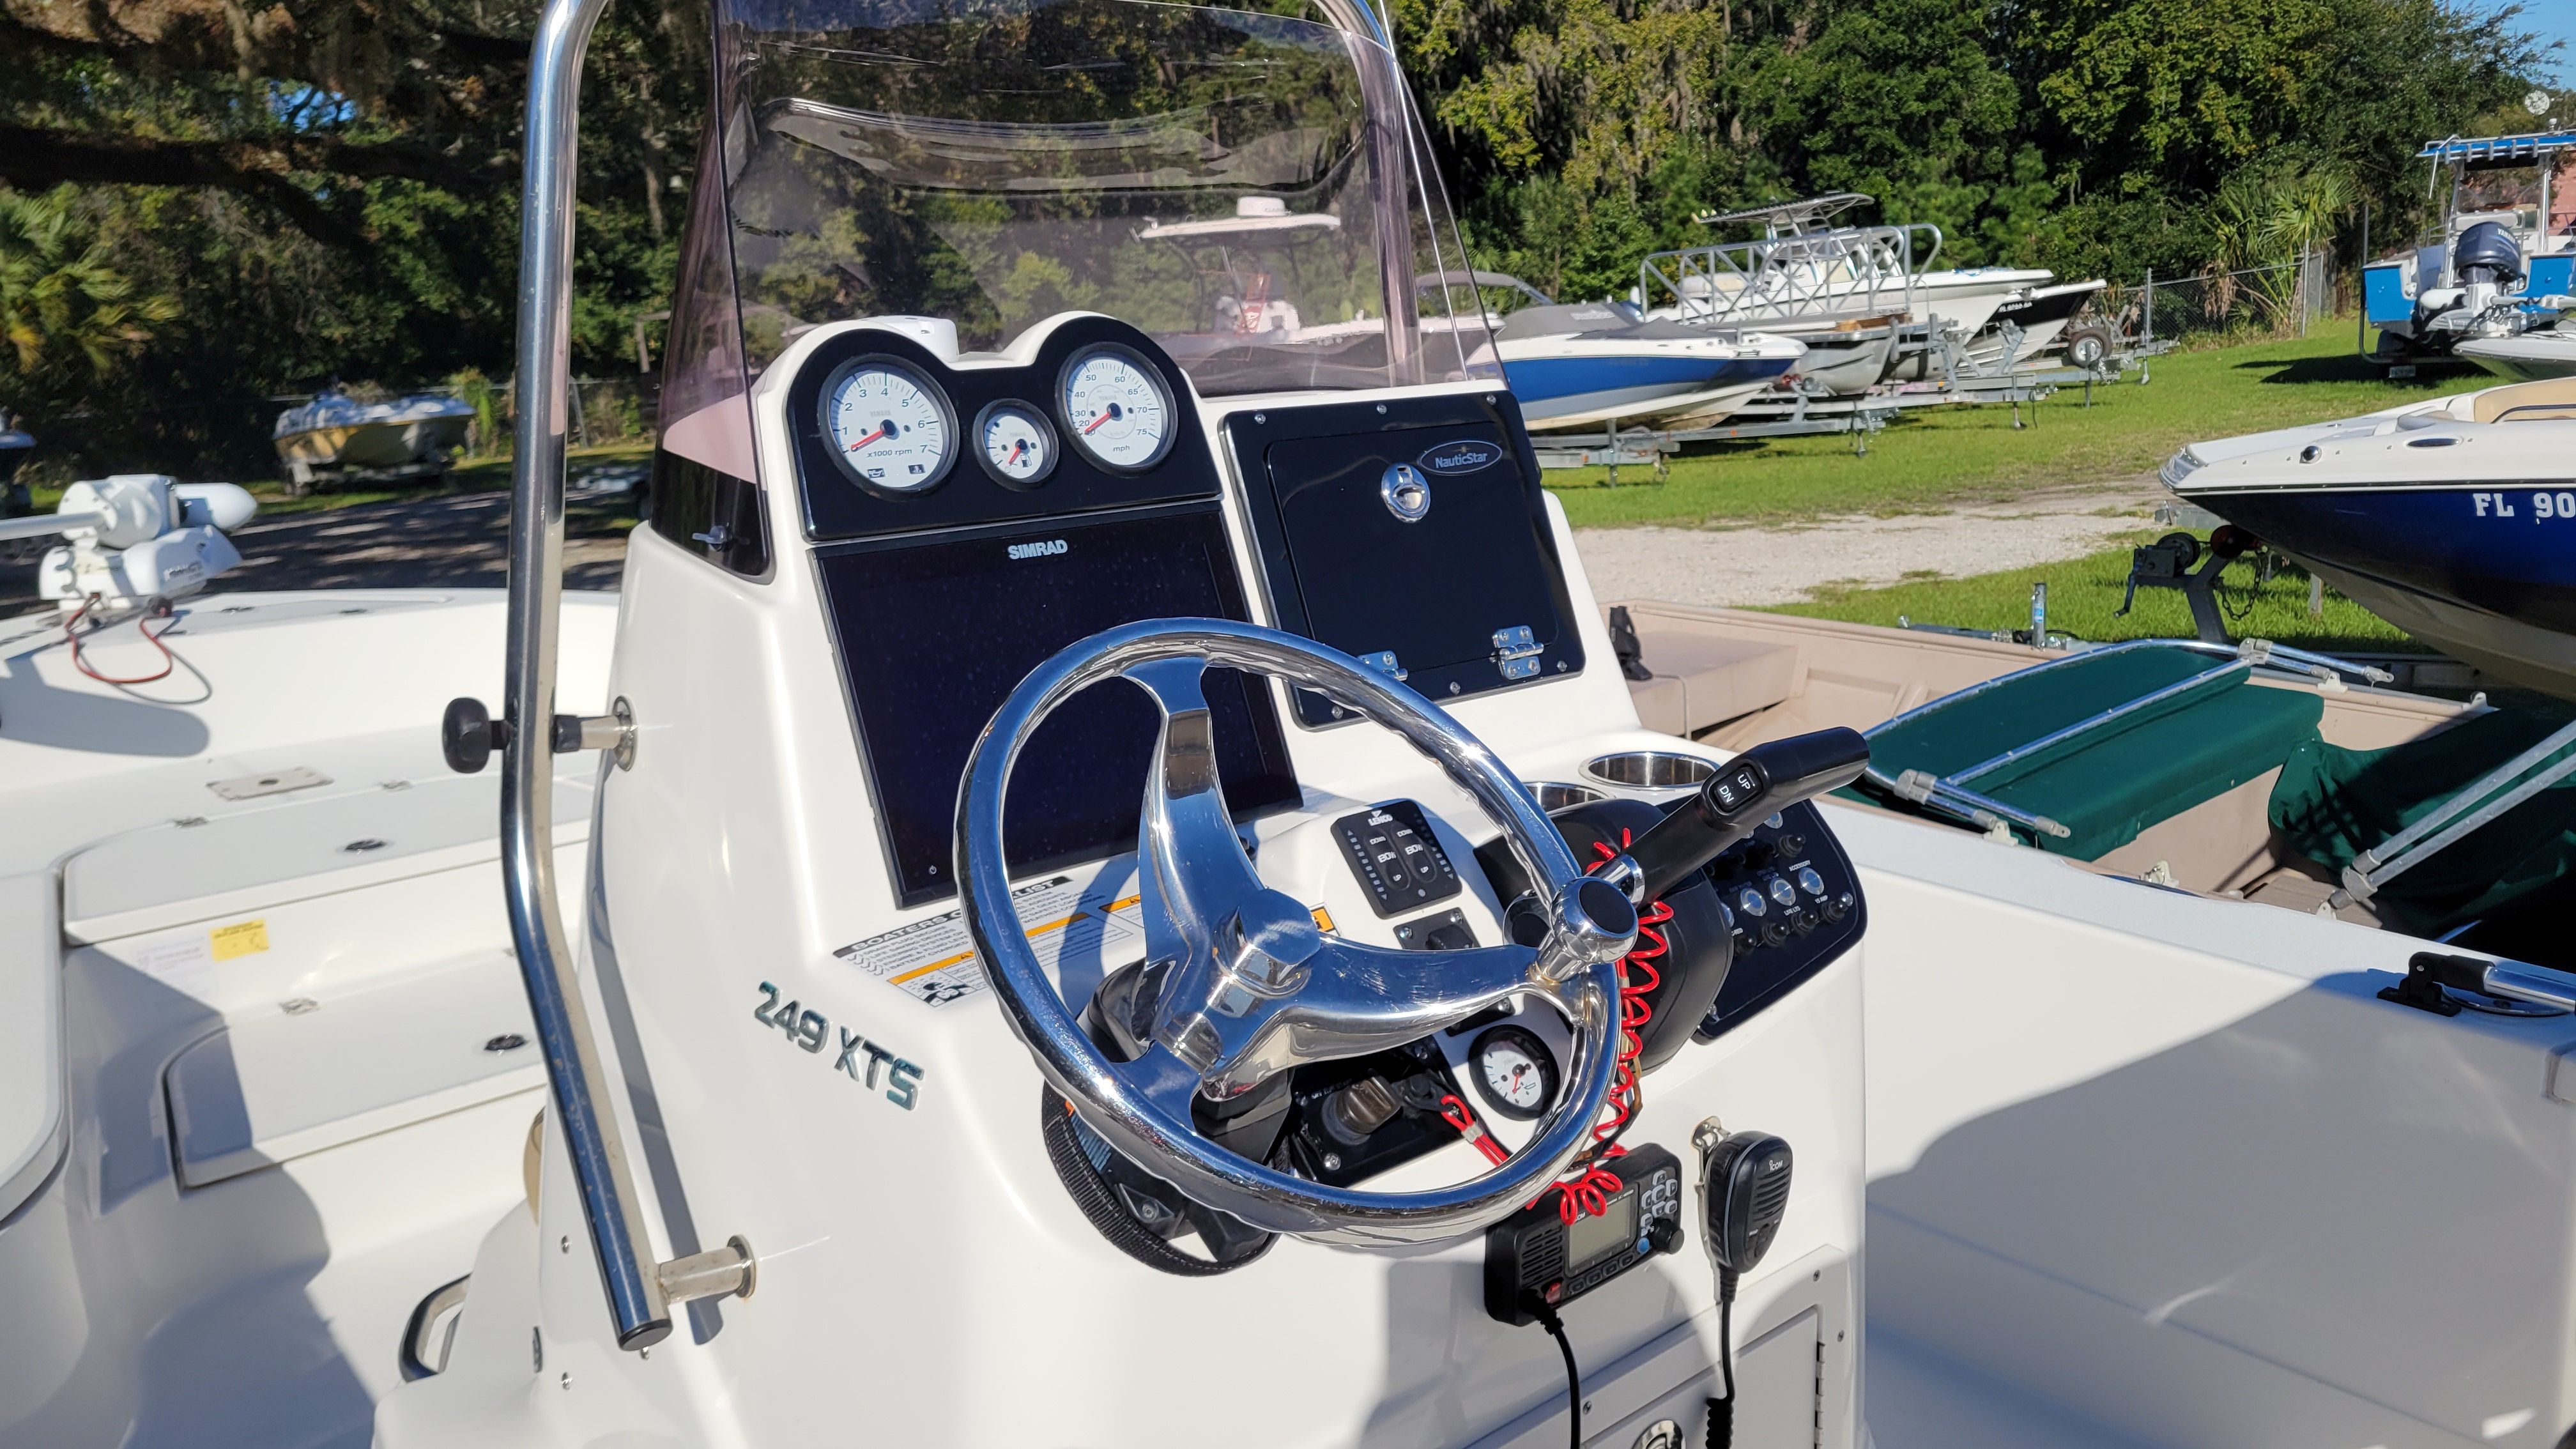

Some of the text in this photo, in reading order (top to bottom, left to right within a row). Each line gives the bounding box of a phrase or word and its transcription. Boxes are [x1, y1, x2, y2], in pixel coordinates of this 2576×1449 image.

[859, 389, 867, 397] 3
[881, 388, 888, 396] 4
[902, 399, 908, 407] 5
[843, 427, 848, 435] 1
[867, 449, 893, 457] x1000
[920, 445, 928, 453] 7
[1435, 452, 1487, 468] NauticStar
[2472, 492, 2576, 518] FL 90
[1008, 540, 1068, 560] SIMRAD
[1738, 774, 1751, 789] UP
[1719, 785, 1735, 802] DN
[850, 916, 949, 950] BOATERS
[755, 981, 925, 1111] 249 XTS
